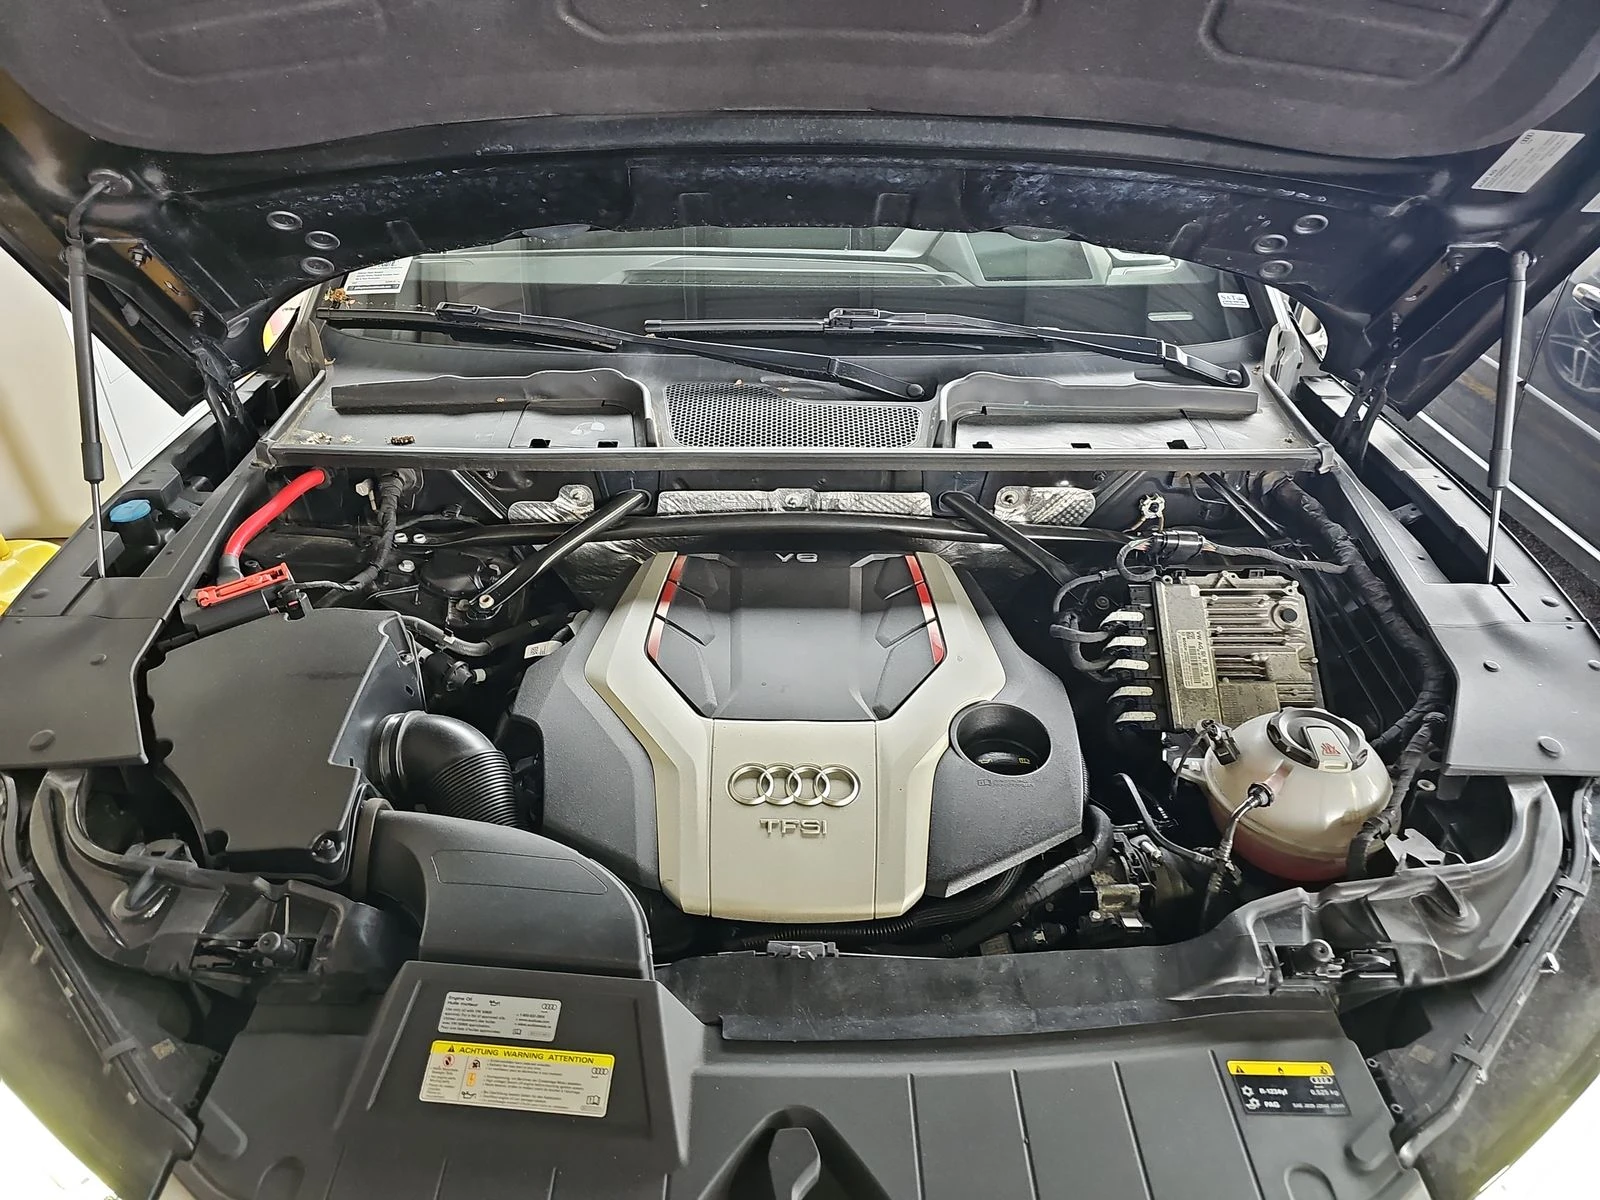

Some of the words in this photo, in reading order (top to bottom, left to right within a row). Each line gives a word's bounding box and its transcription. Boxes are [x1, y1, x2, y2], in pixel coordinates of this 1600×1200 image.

[775, 552, 819, 563] V6
[759, 817, 828, 838] TFSI
[459, 1046, 499, 1057] ACHTUNG
[503, 1050, 544, 1061] WARNING
[548, 1054, 595, 1065] ATTENTION
